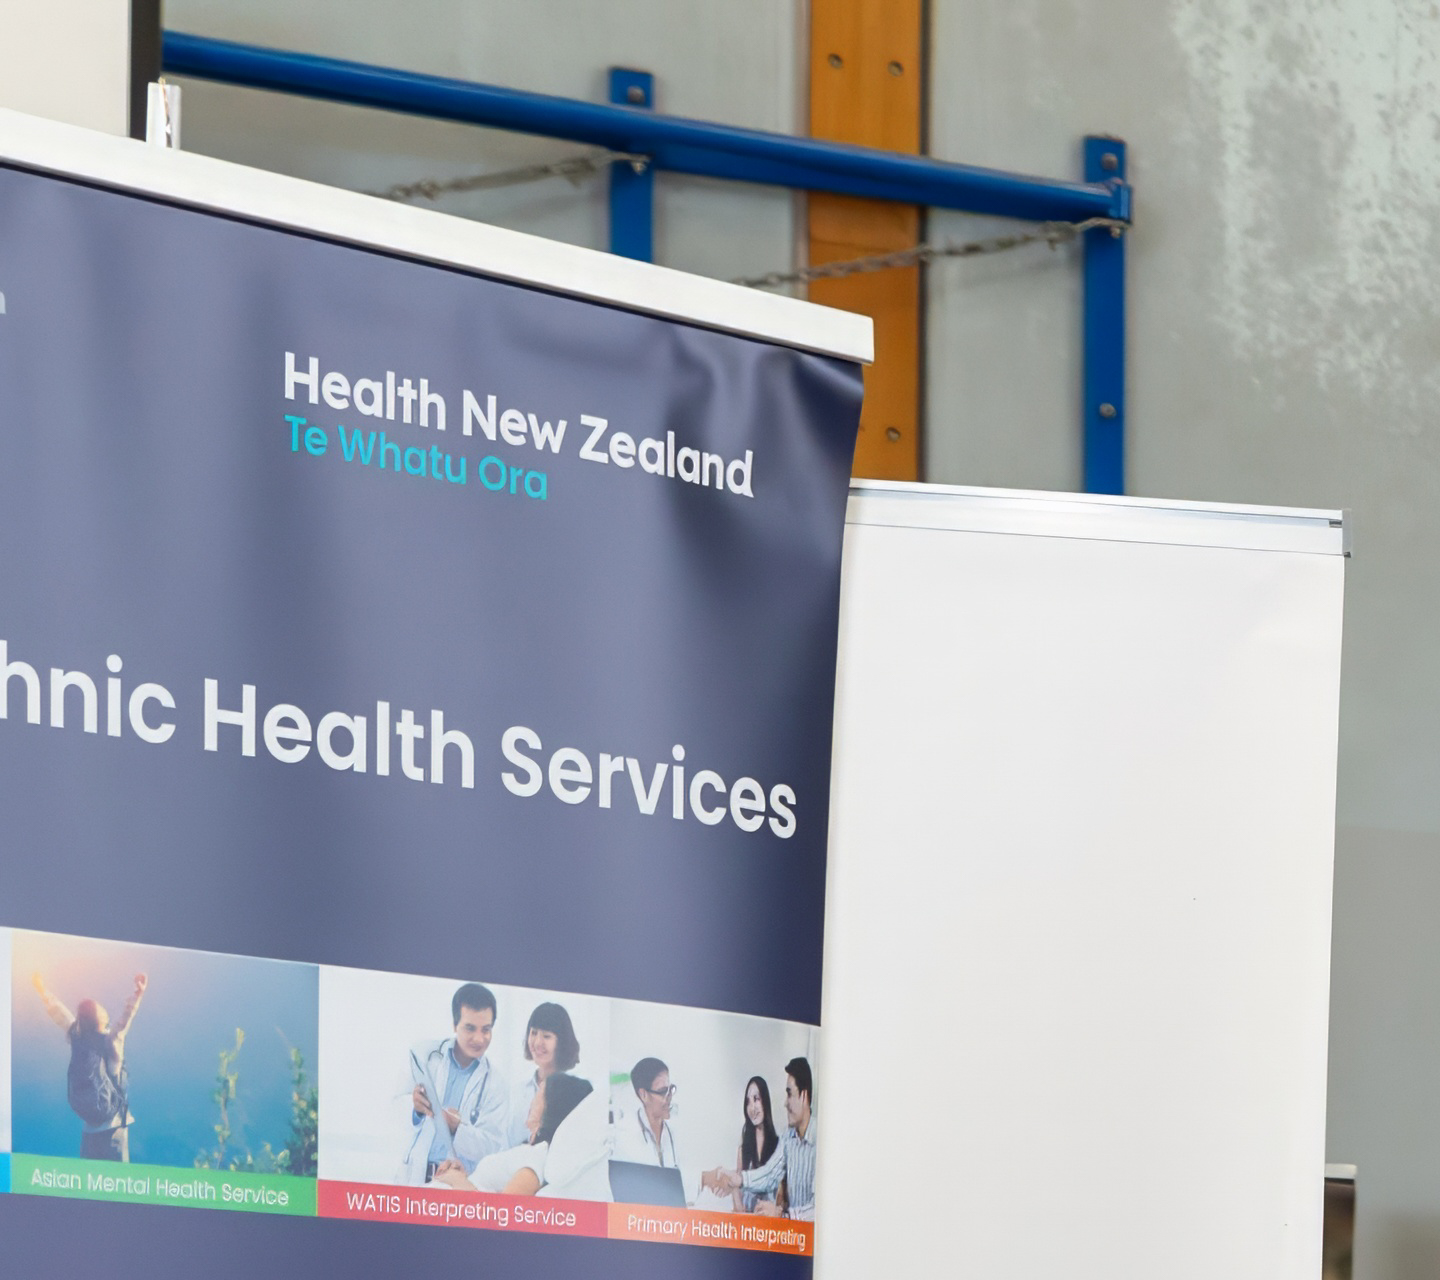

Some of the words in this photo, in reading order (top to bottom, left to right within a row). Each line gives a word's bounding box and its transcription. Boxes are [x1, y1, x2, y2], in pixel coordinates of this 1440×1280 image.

[284, 352, 446, 432] Health
[463, 389, 566, 454] New
[580, 414, 753, 499] Zealand
[284, 415, 328, 457] Te
[338, 425, 468, 487] Whatu
[479, 456, 548, 501] Ora
[203, 677, 475, 790] Health
[500, 725, 798, 840] Services
[31, 1167, 81, 1190] Asian
[87, 1170, 150, 1196] Mental
[155, 1176, 216, 1200] Health
[222, 1182, 289, 1207] Service
[346, 1192, 400, 1215] WATIS
[405, 1197, 509, 1227] Interpreting
[513, 1205, 576, 1227] Service
[627, 1214, 687, 1239] Primary
[691, 1218, 737, 1240] Health
[740, 1224, 806, 1253] Interpreting
